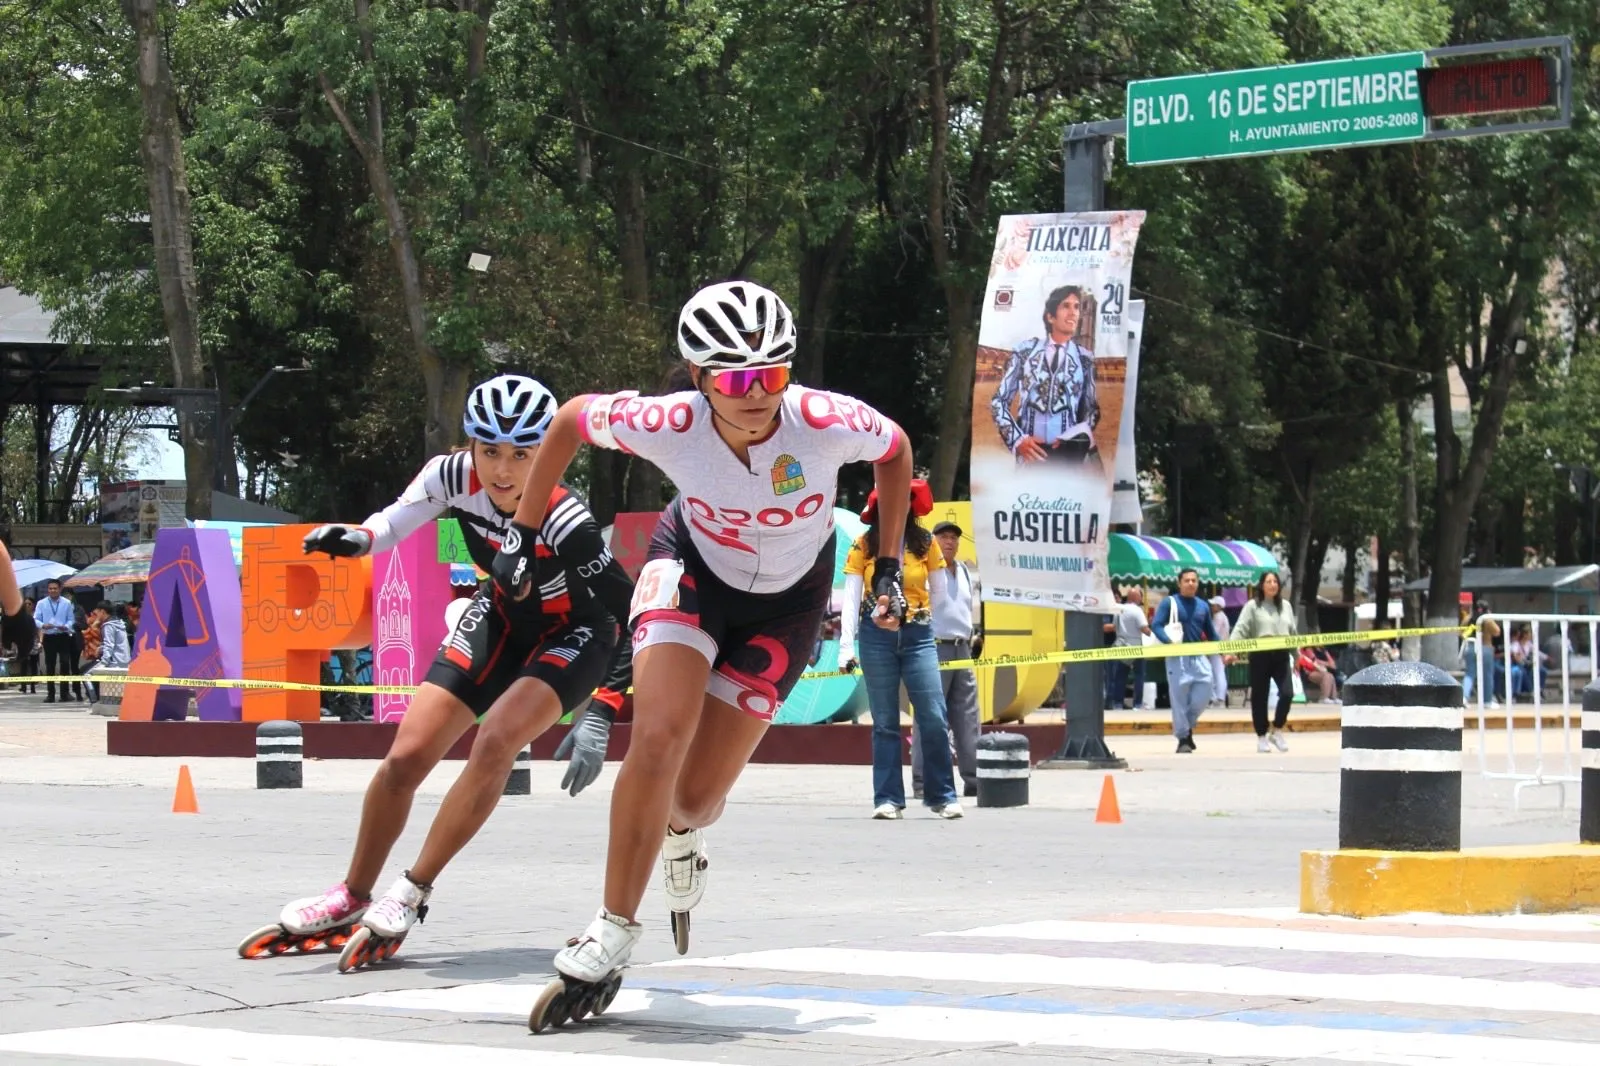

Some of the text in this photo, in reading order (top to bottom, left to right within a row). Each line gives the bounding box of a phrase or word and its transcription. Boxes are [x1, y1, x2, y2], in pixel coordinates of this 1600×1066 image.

[1132, 69, 1419, 127] BLVD. 16 DE SEPTIEMBRE
[1452, 71, 1528, 104] ALTO
[1229, 111, 1419, 144] H. AYUNTAMIENTO 2005-2008
[1026, 225, 1111, 252] TLAXCALA
[1100, 283, 1125, 315] 29
[1012, 492, 1082, 512] Sebastián
[994, 510, 1100, 545] CASTELLA
